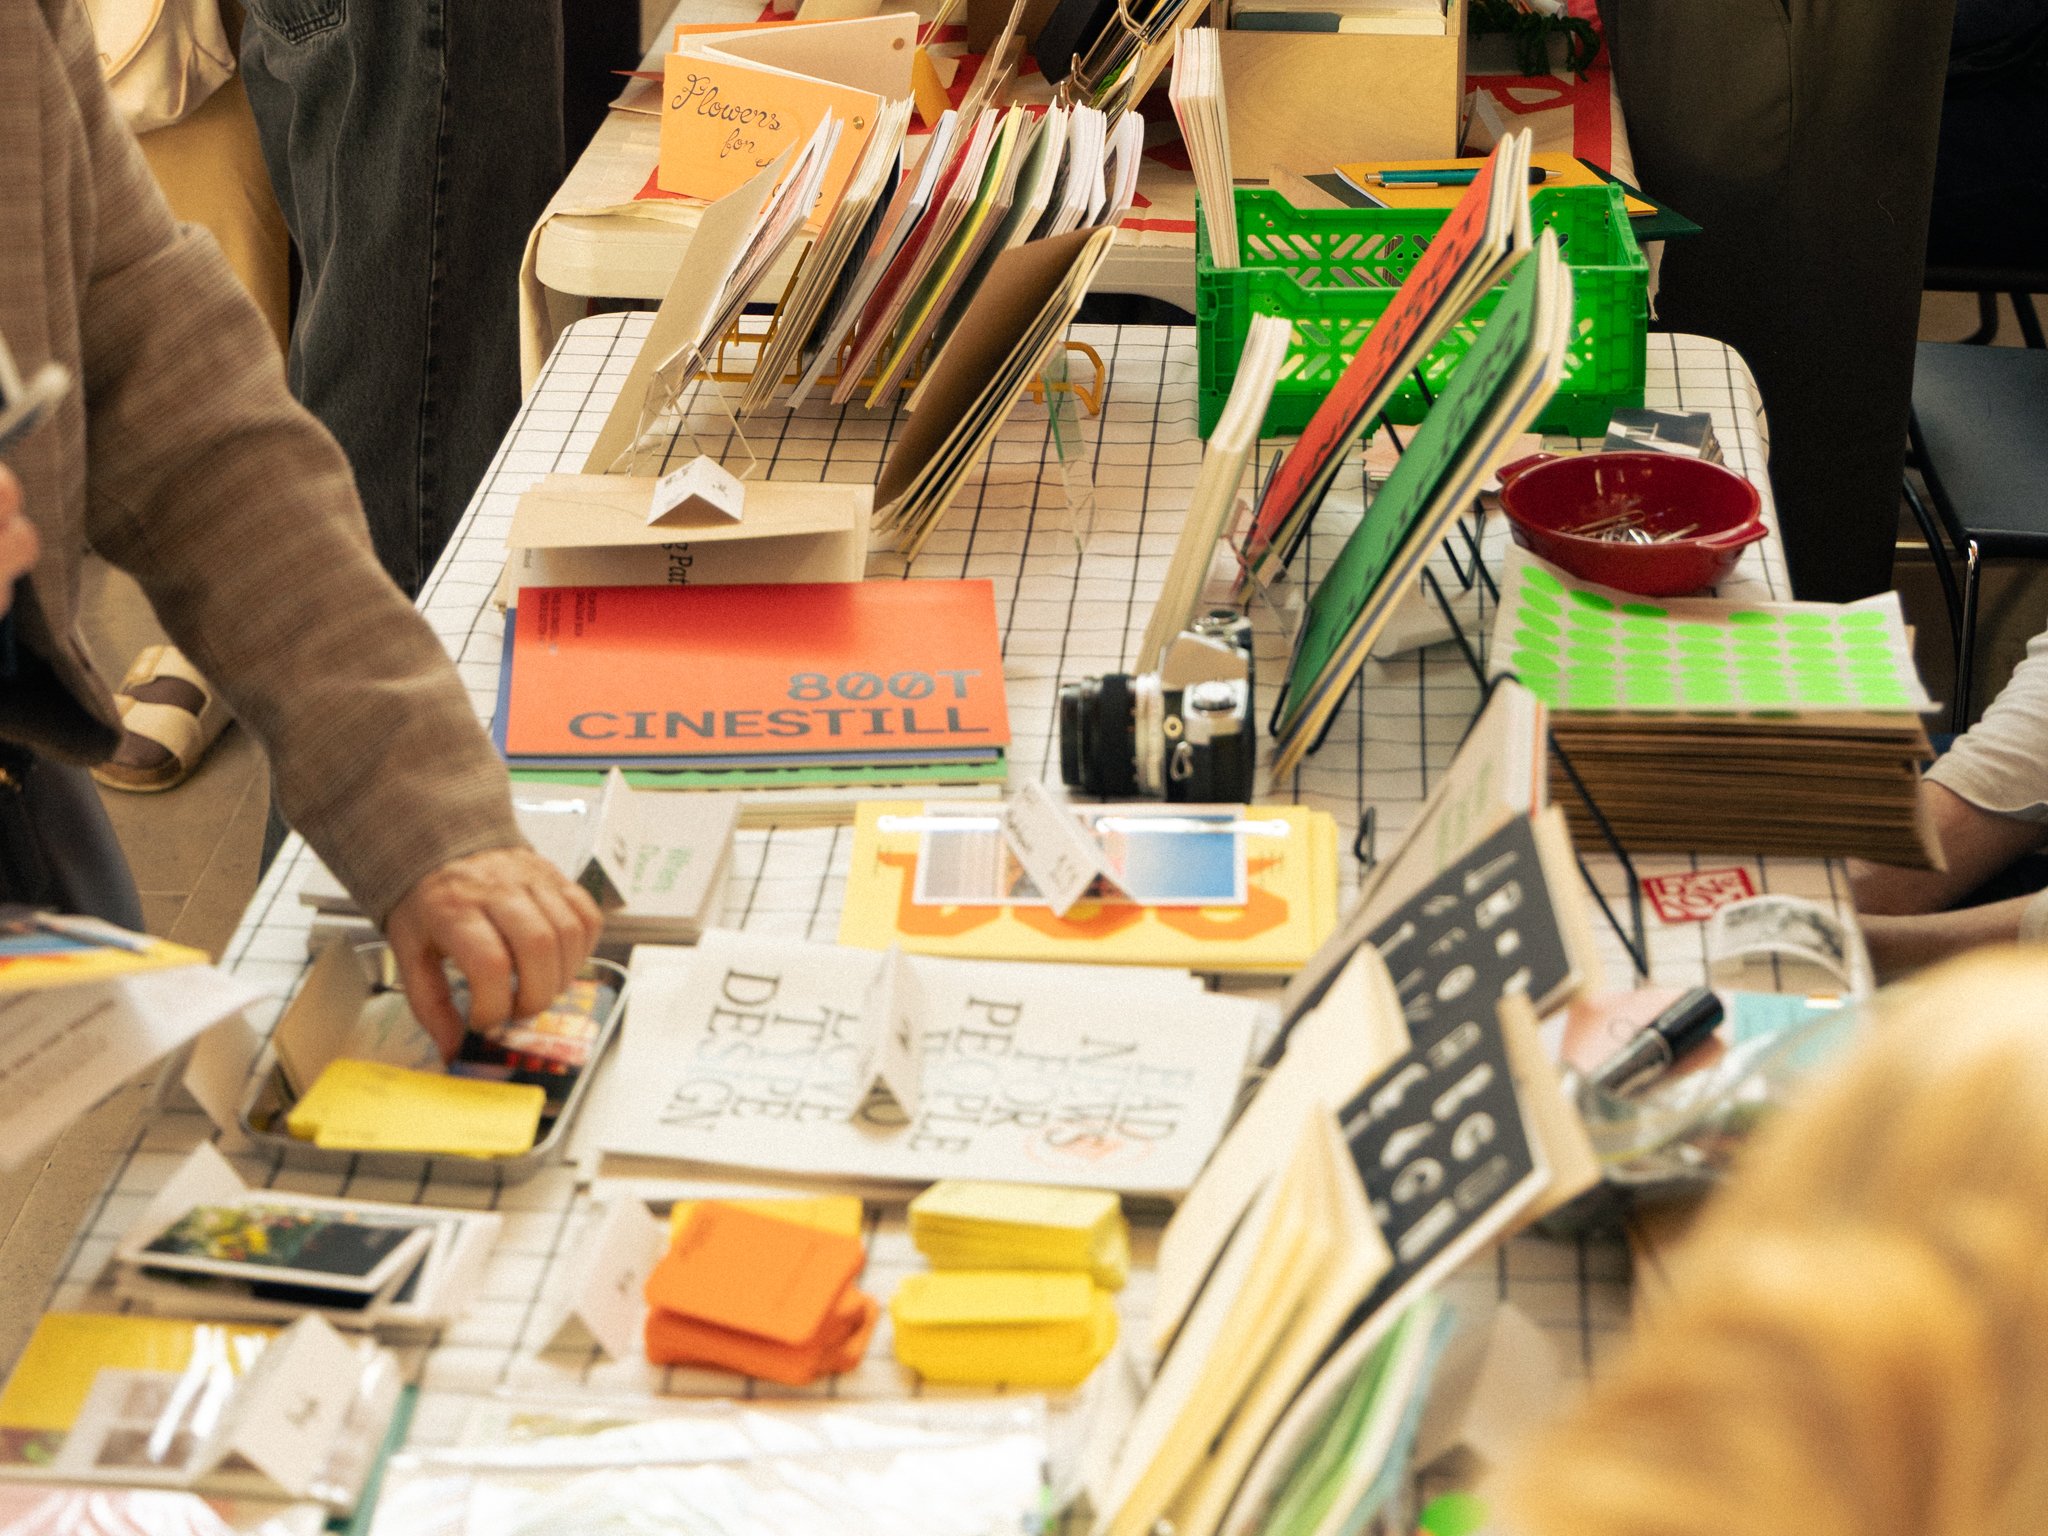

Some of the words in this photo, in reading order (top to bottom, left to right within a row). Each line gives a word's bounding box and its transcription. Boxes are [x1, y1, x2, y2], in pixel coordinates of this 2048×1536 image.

[671, 74, 781, 131] Flowers
[719, 128, 755, 158] for
[568, 706, 990, 740] CINESTILL
[787, 670, 982, 701] 800T
[658, 967, 781, 1132] DESIGN
[731, 1002, 830, 1119] TYPE
[908, 995, 1023, 1152] PEOPLE
[987, 1048, 1072, 1129] FOR
[1044, 1034, 1139, 1148] NEWS
